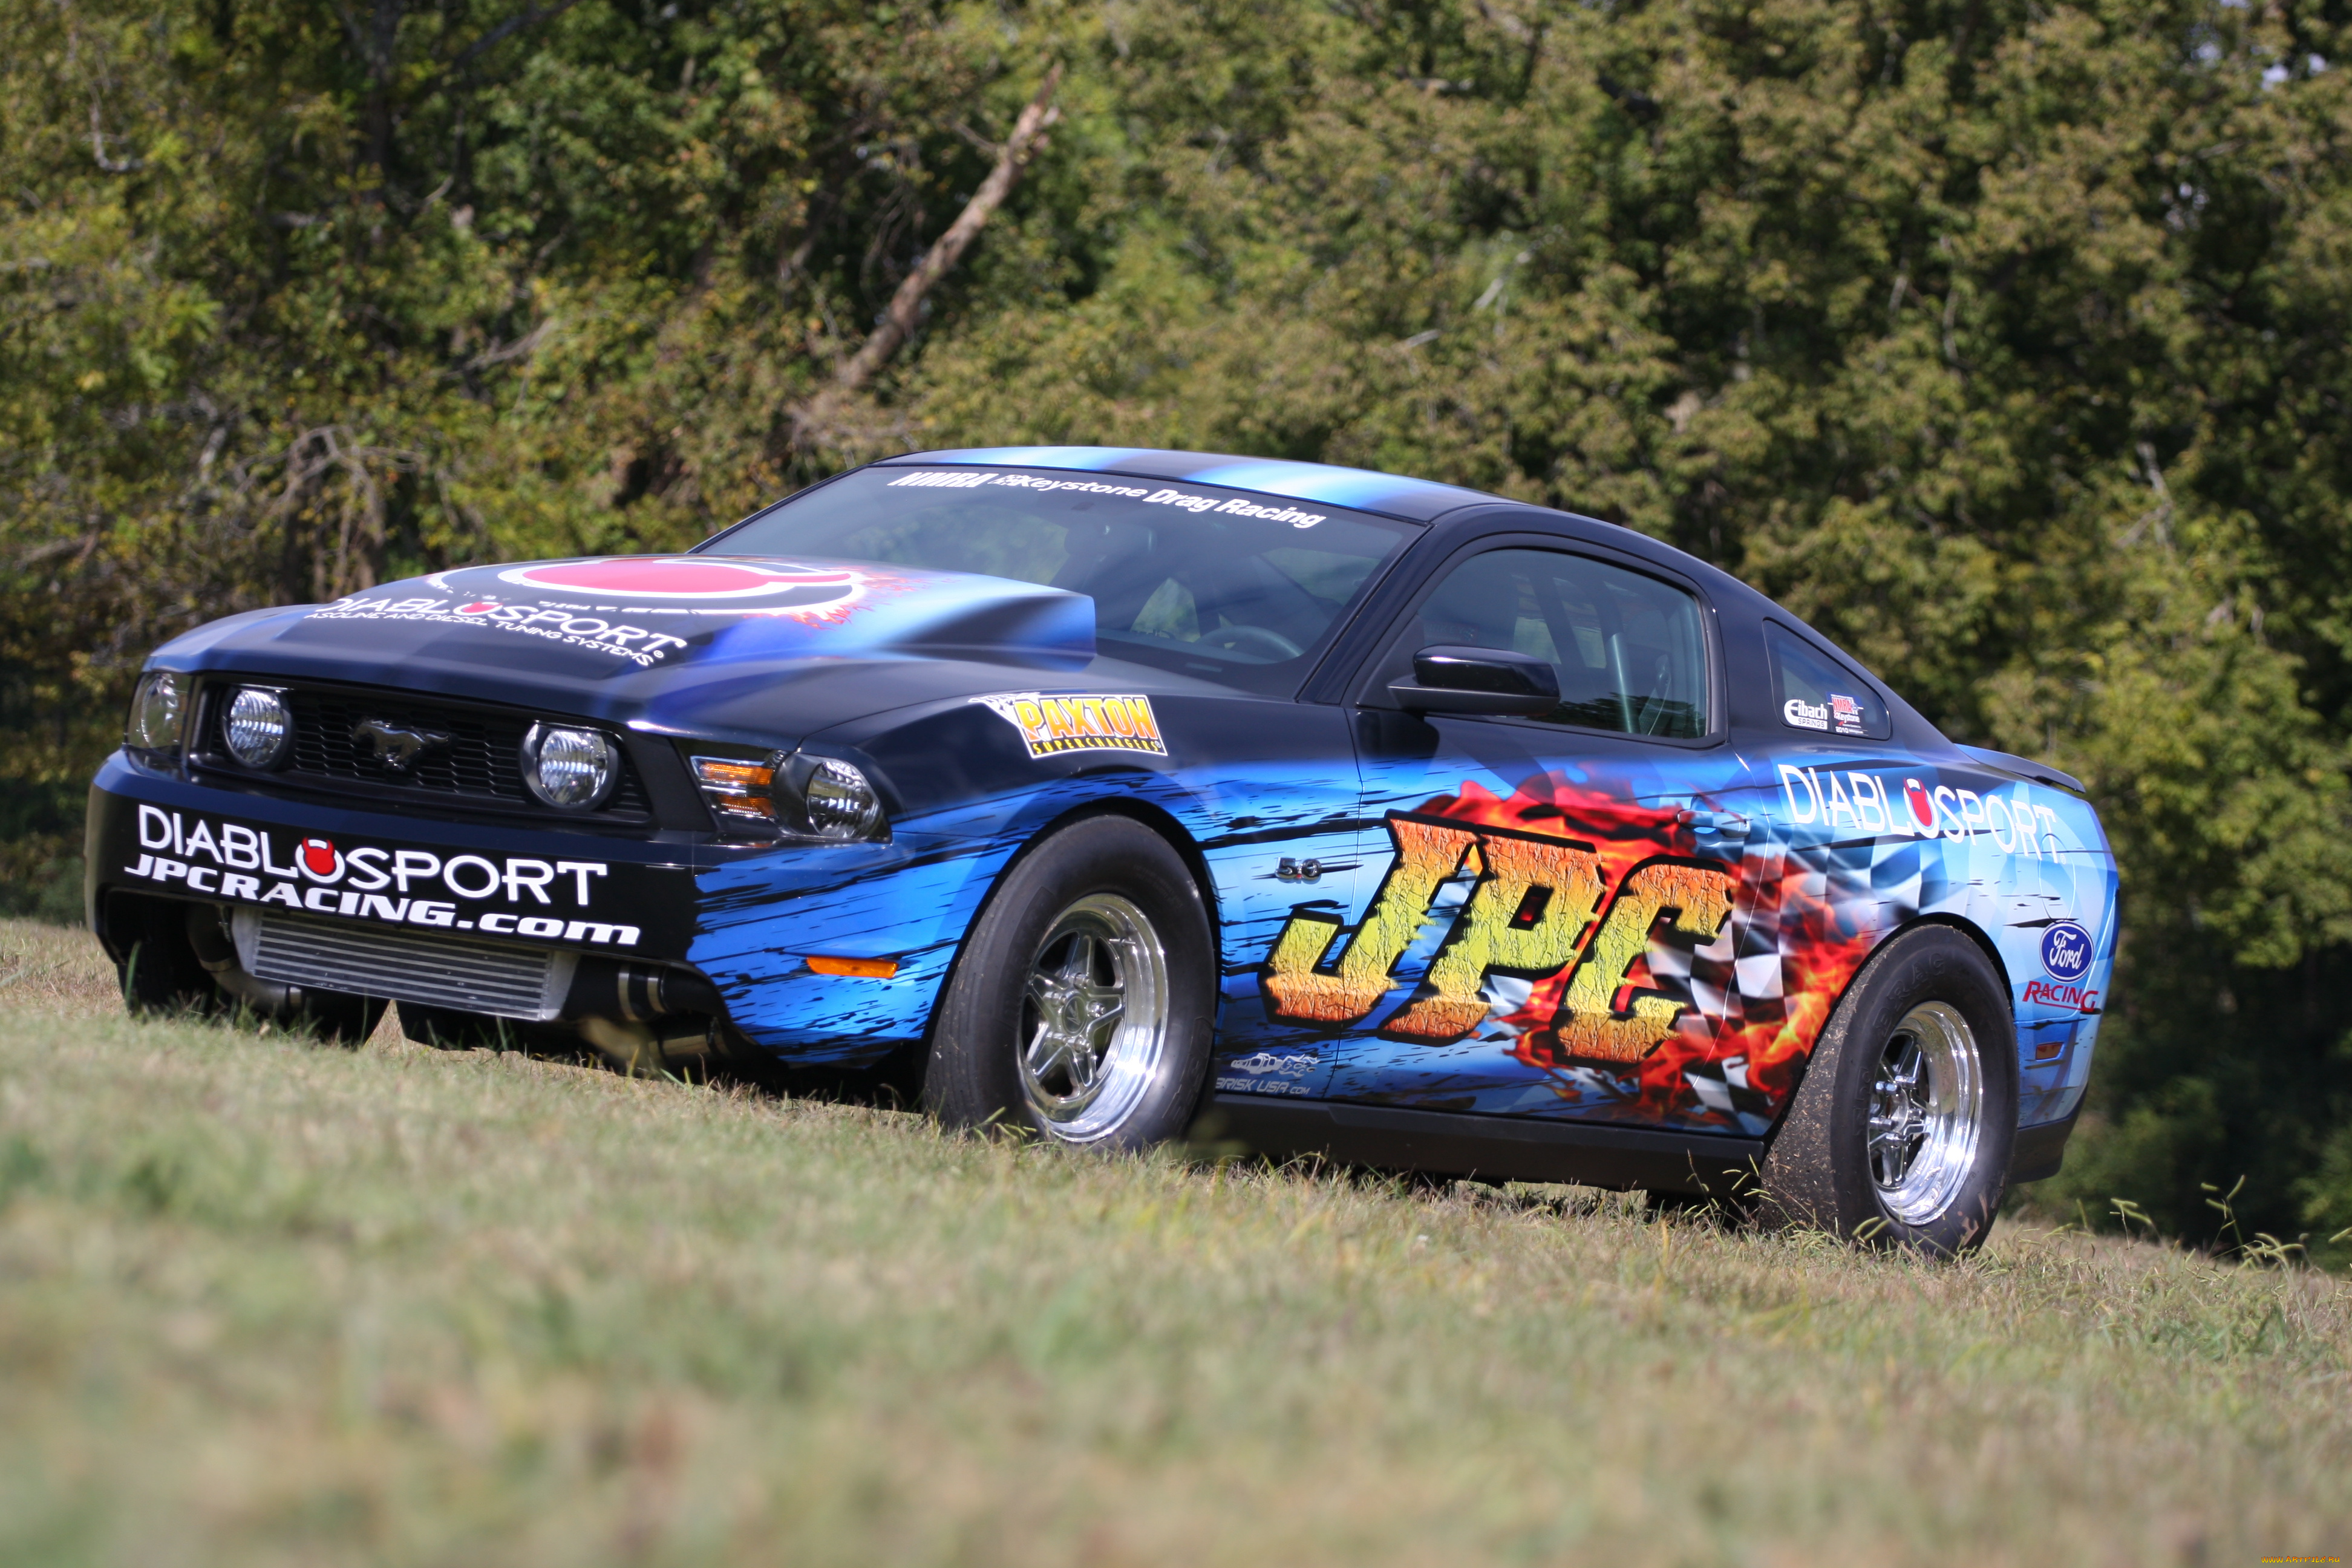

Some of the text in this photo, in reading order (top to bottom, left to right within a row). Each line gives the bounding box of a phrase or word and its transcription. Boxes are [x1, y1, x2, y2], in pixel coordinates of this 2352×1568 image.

[1013, 476, 1149, 497] Keystone
[1143, 489, 1220, 512] Drag
[1214, 498, 1327, 529] Racing
[425, 614, 488, 626] DIESEL
[495, 621, 563, 639] TUNING
[563, 635, 654, 666] SYSTEMS
[1014, 697, 1158, 742] PAXTON
[1784, 699, 1828, 722] Eibach
[1797, 717, 1825, 728] SPRINGS
[1032, 737, 1160, 755] SUPERCHARGERS
[1777, 764, 2059, 864] DIABLOSPORT
[138, 804, 608, 906] DIABLOSPORT
[125, 854, 641, 946] JPCRACING.com
[1258, 811, 1736, 1063] JPC
[2049, 930, 2085, 970] Ford
[2022, 981, 2099, 1013] RACING
[1256, 1080, 1290, 1093] USA
